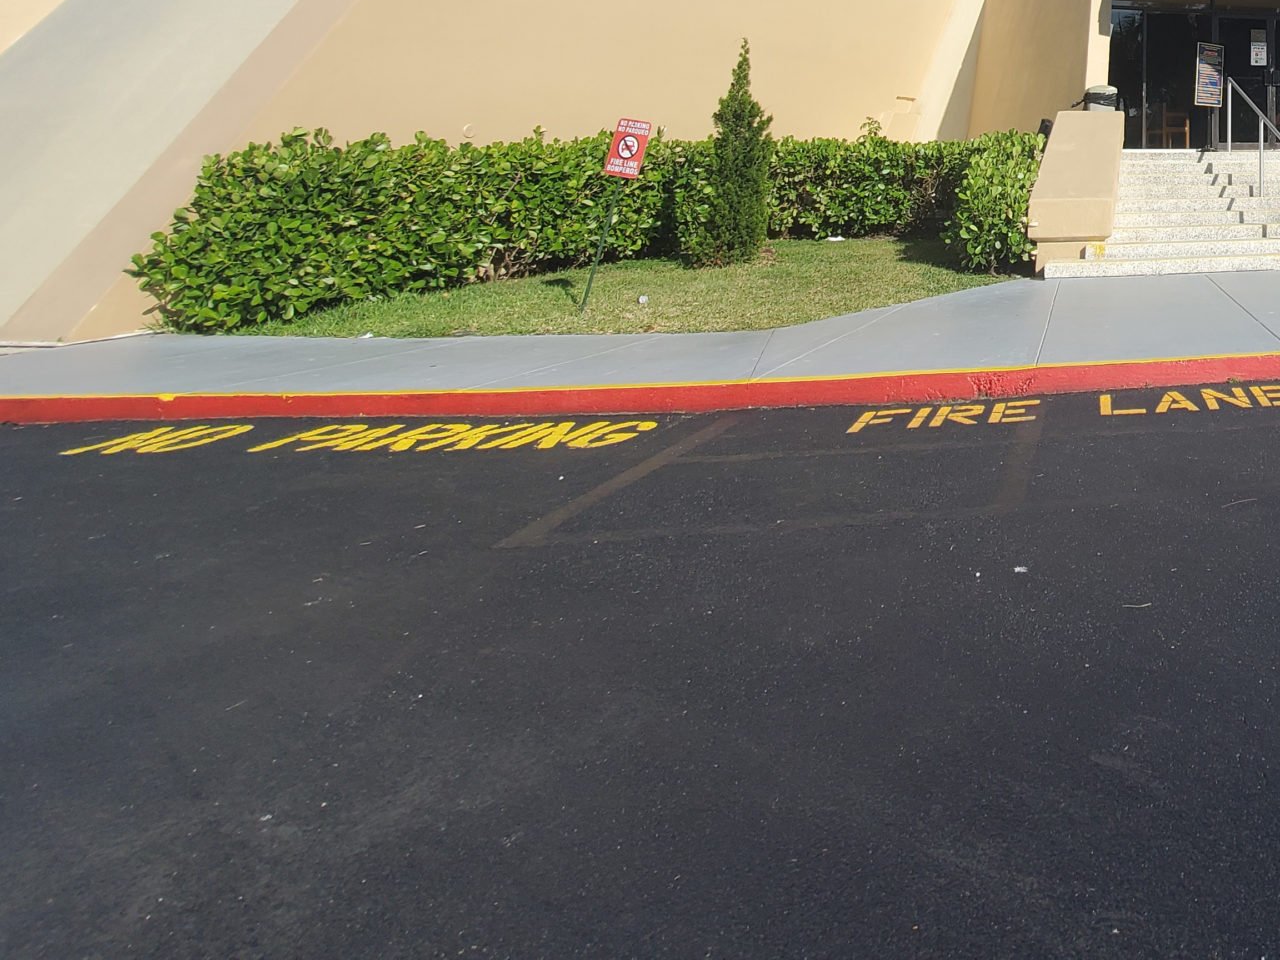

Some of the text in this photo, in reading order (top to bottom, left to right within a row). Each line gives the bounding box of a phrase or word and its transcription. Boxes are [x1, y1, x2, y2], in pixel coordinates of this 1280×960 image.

[846, 398, 1041, 434] FIRE
[58, 421, 658, 455] NO PARKING
